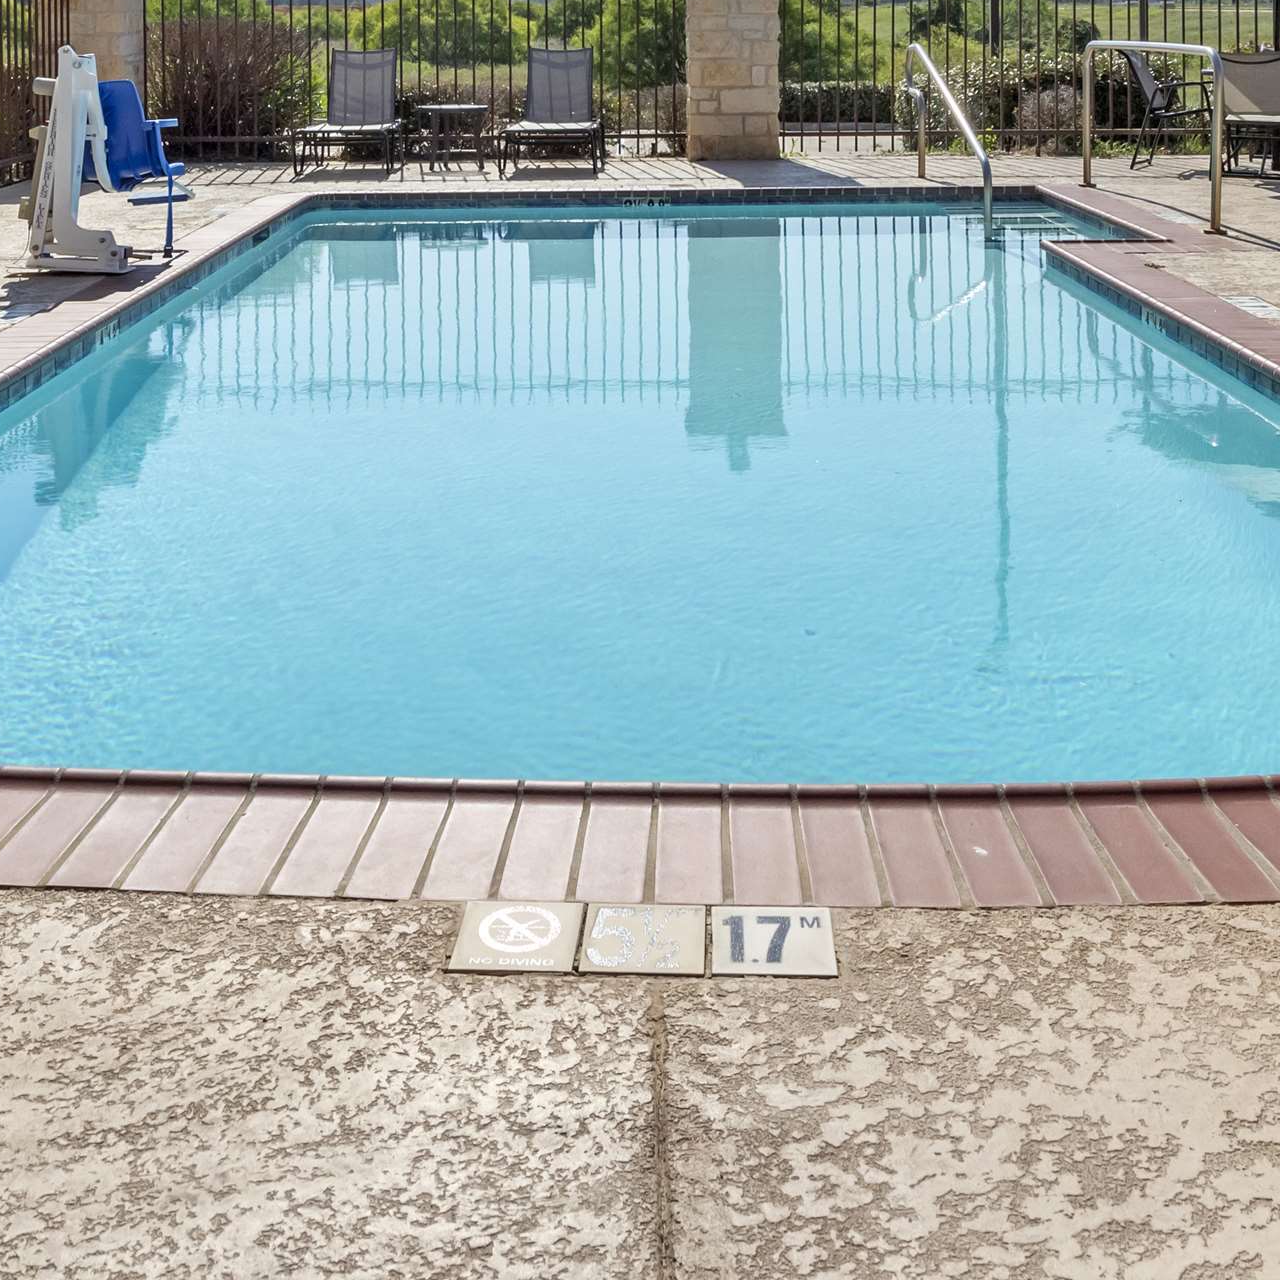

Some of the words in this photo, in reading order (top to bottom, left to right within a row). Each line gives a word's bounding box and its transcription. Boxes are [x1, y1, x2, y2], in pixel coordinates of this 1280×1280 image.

[722, 916, 791, 963] 1.7
[800, 916, 822, 929] M
[468, 957, 493, 966] NO
[498, 957, 555, 967] DIVING
